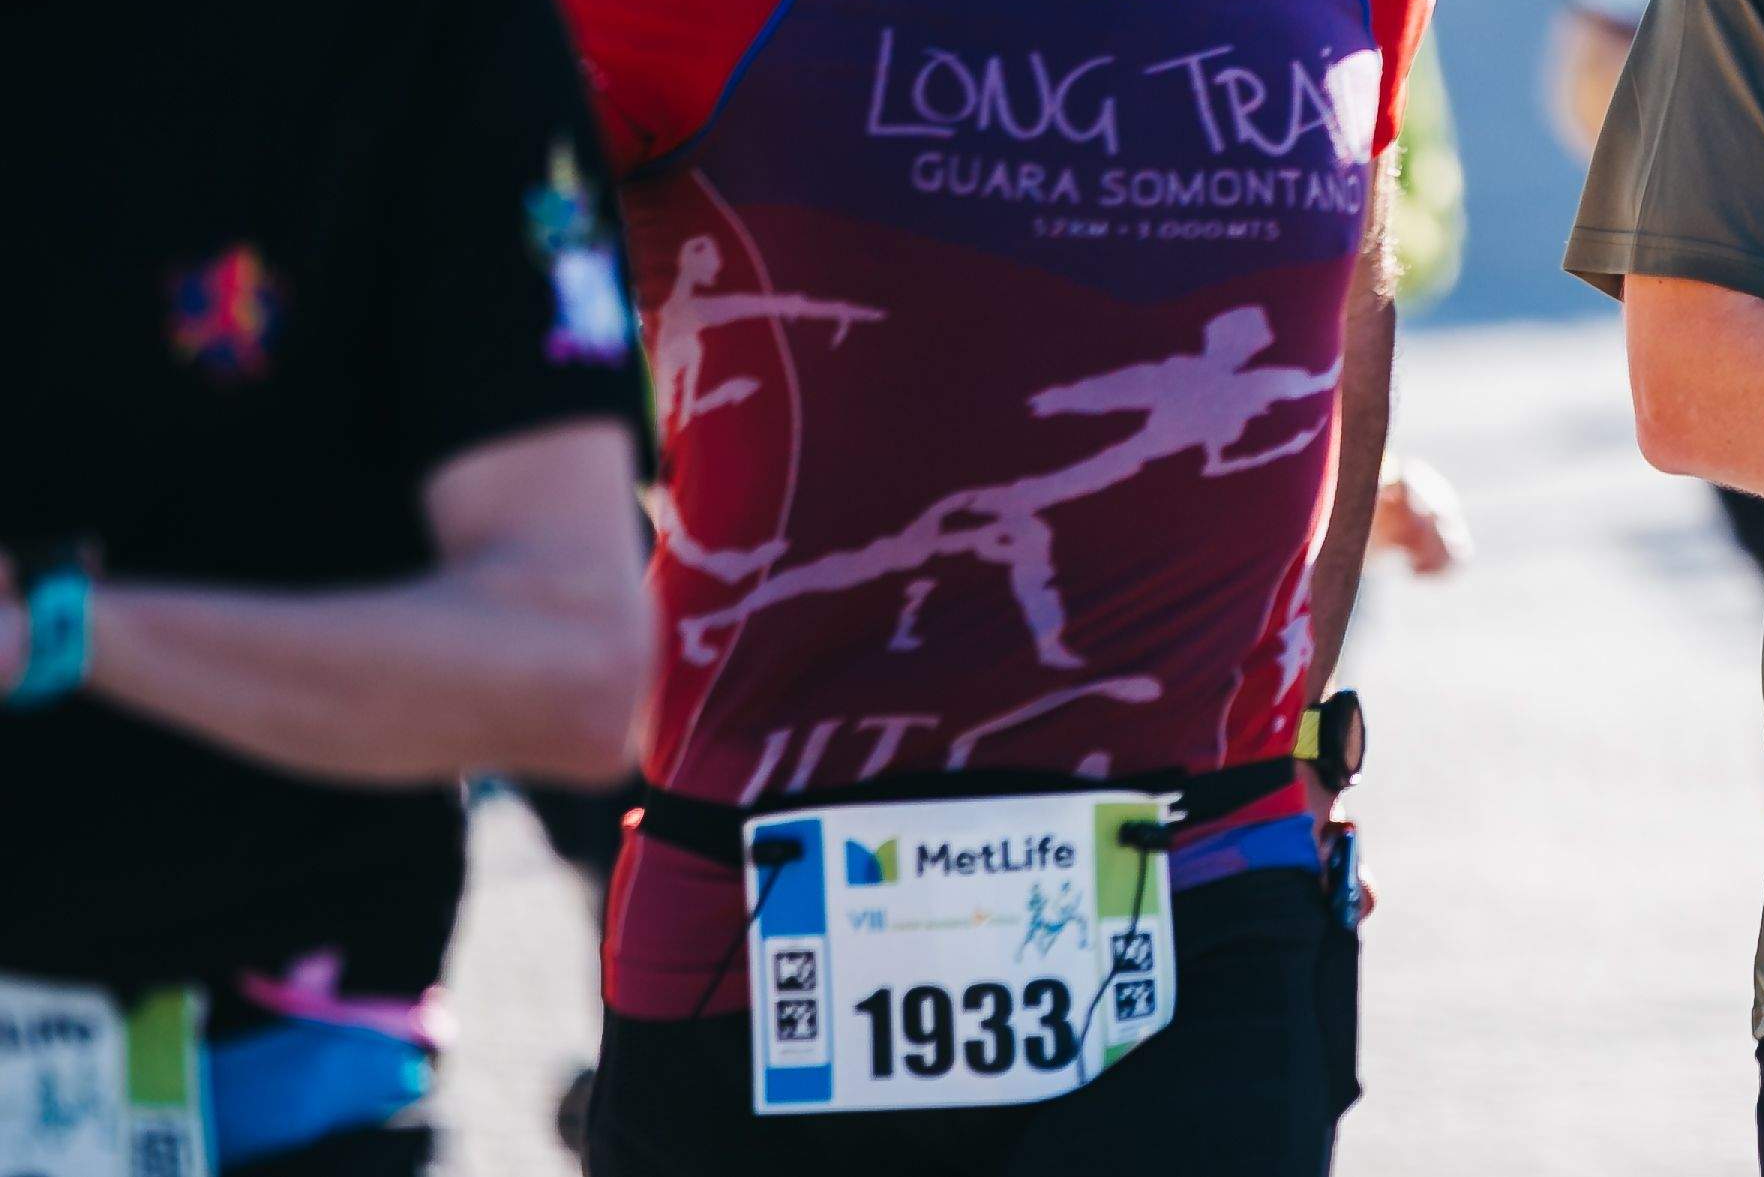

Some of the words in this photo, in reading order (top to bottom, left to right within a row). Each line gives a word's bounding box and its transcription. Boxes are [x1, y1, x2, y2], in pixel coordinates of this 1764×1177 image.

[867, 27, 1117, 155] LONG
[912, 152, 1081, 203] GUARA
[1101, 167, 1361, 215] SOMONTANO
[915, 835, 1076, 878] MetLife
[855, 977, 1082, 1081] 1933
